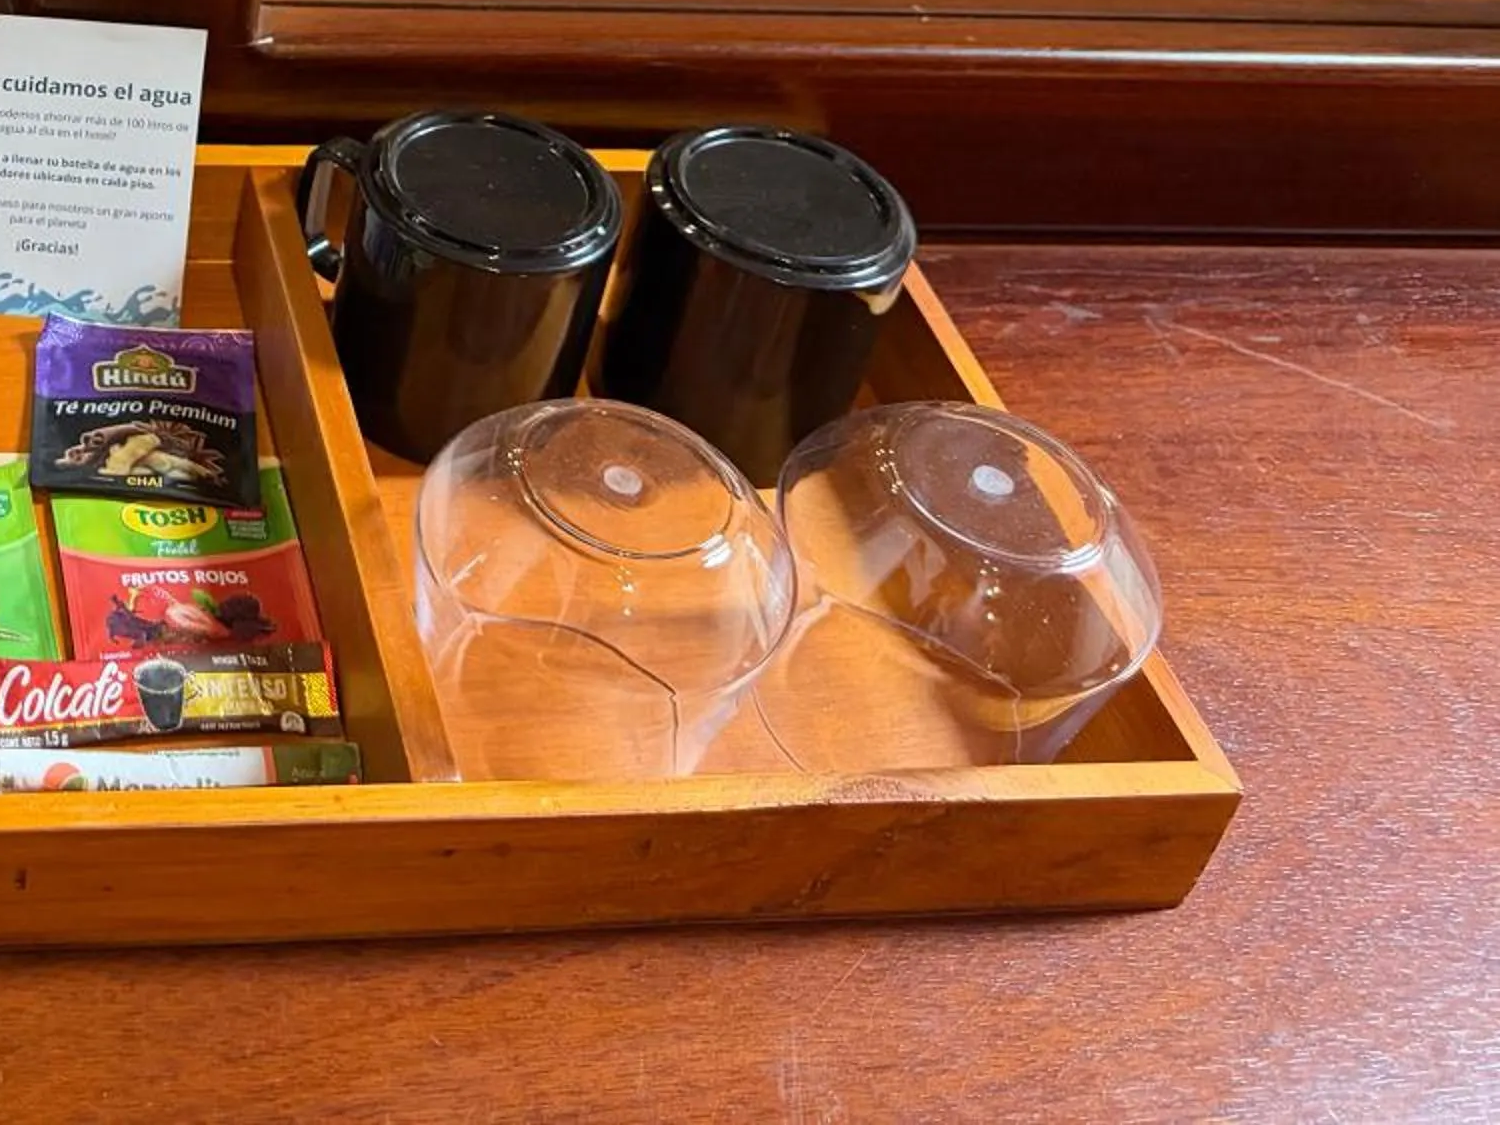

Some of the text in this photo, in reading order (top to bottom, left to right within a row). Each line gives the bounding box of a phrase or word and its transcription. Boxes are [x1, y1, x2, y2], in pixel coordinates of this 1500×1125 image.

[3, 76, 108, 99] cuidamos
[114, 83, 134, 101] el
[140, 88, 193, 108] agua
[15, 237, 80, 256] ¡Gracias!
[102, 368, 188, 389] Hindú
[54, 399, 238, 431] Té negro Premium
[126, 476, 164, 489] CHAI
[134, 506, 208, 528] TOSH
[120, 569, 249, 588] FRUTOS ROJOS
